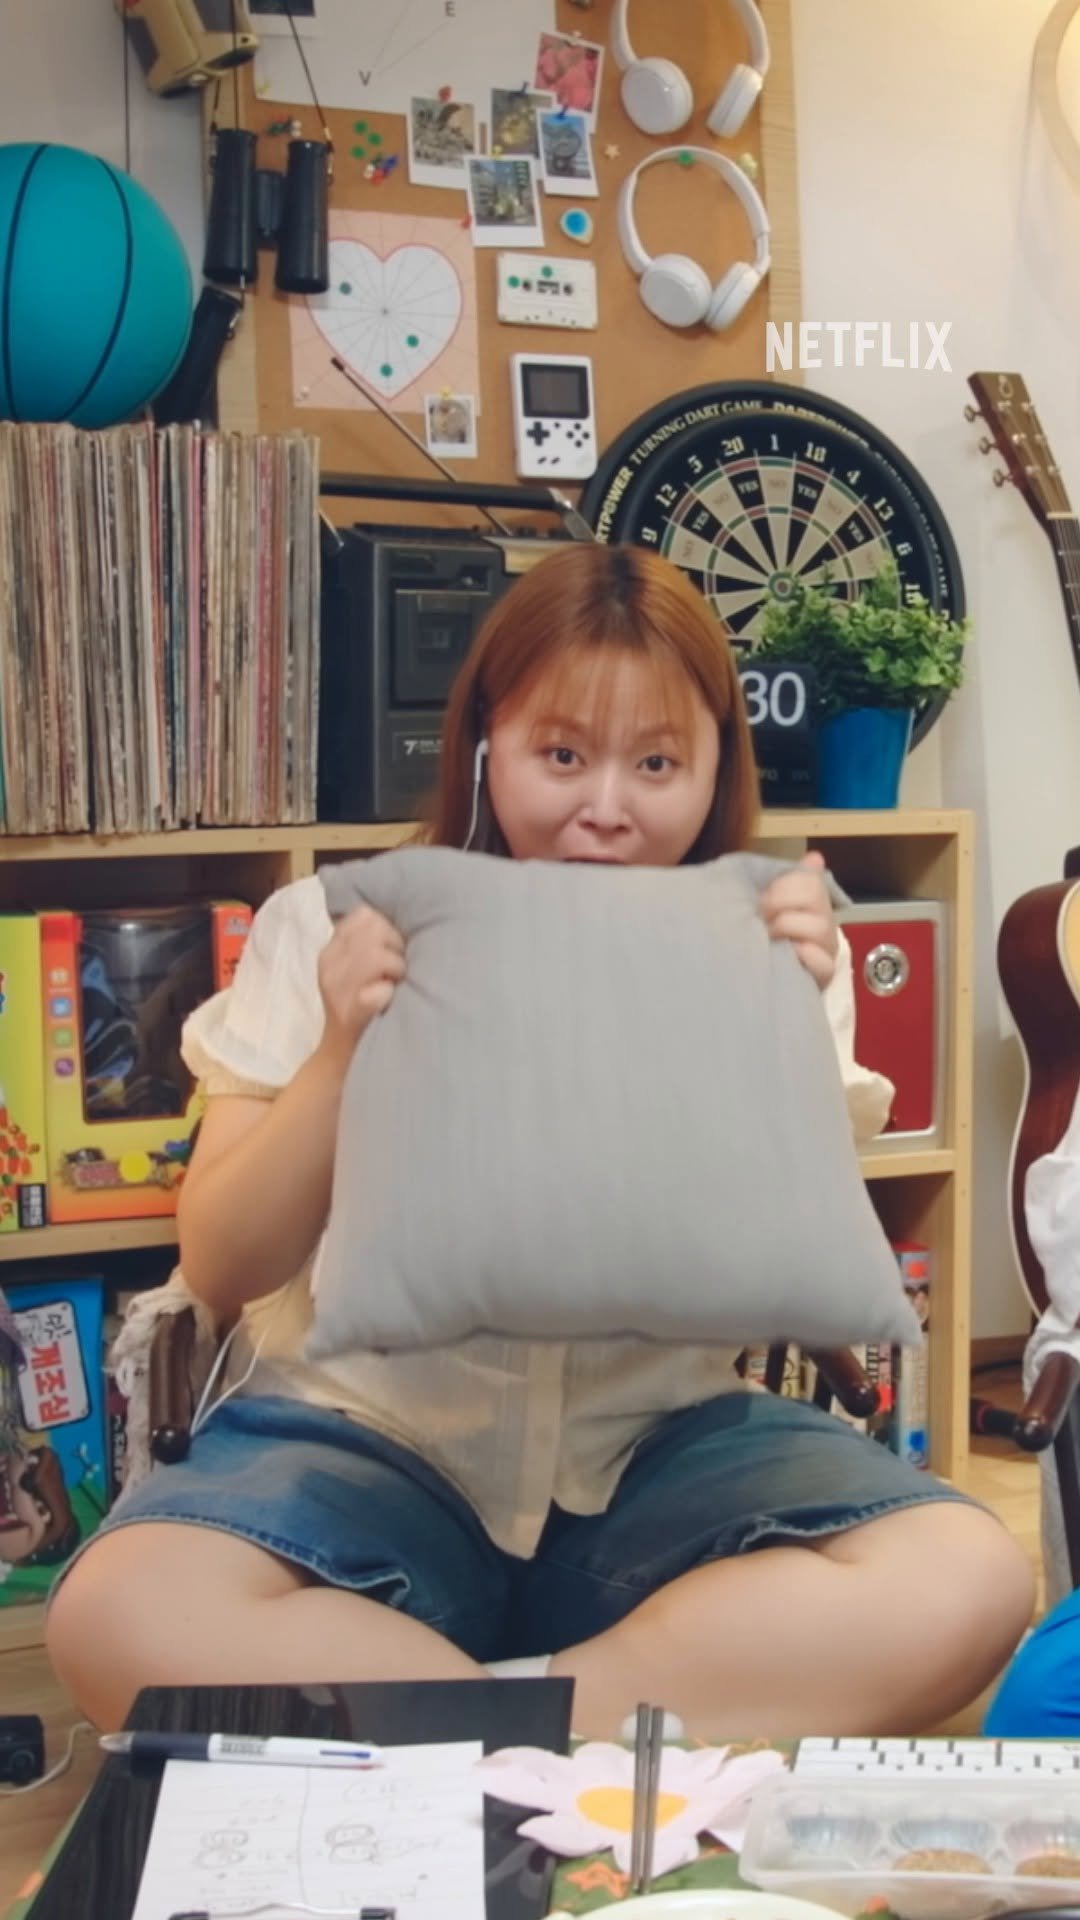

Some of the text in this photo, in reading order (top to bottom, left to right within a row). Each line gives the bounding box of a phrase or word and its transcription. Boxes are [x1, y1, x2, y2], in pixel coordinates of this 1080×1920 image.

[445, 0, 457, 18] E
[358, 69, 372, 87] V
[628, 418, 687, 466] TURNING
[685, 402, 722, 426] DART
[720, 399, 764, 414] GAME
[770, 433, 780, 451] 1
[721, 436, 745, 457] 20
[804, 441, 828, 463] 18
[687, 455, 703, 475] 5
[846, 469, 862, 485] 4
[655, 483, 678, 508] 12
[737, 480, 759, 495] YES
[797, 482, 819, 499] YES
[873, 497, 895, 521] 13
[692, 513, 710, 531] YES
[641, 526, 658, 543] 9
[848, 521, 865, 543] YES
[896, 542, 913, 557] 6
[738, 670, 806, 726] 30
[30, 1340, 71, 1424] 개조심
